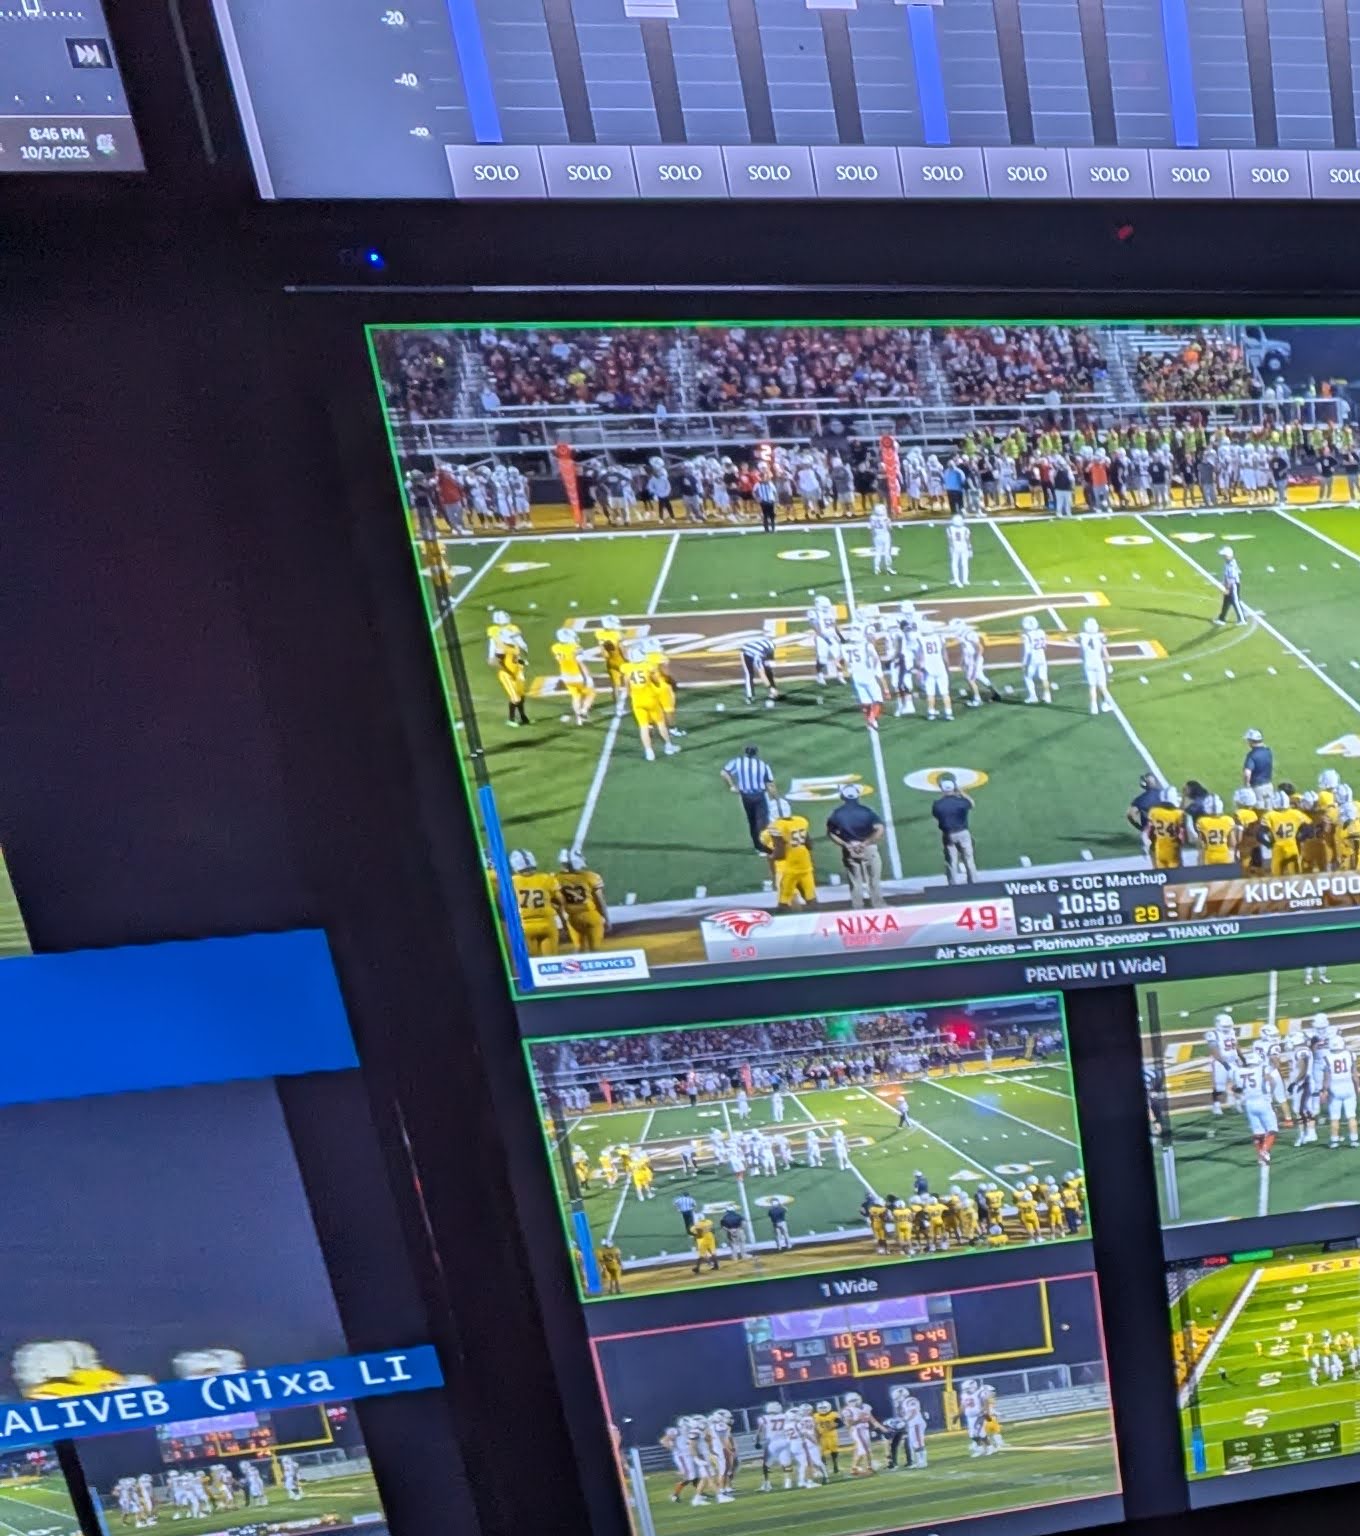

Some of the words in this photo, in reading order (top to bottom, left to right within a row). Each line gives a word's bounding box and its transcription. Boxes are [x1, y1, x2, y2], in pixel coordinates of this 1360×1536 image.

[381, 10, 405, 26] -20
[394, 72, 418, 87] -40
[29, 127, 59, 141] 8:46
[60, 127, 86, 141] PM
[20, 145, 91, 160] 10/3/2025
[474, 165, 519, 182] SOLO
[567, 165, 612, 182] SOLO
[659, 165, 702, 182] SOLO
[748, 165, 791, 182] SOLO
[836, 165, 878, 182] SOLO
[922, 165, 963, 182] SOLO
[1007, 166, 1047, 183] SOLO
[1090, 167, 1129, 183] SOLO
[1171, 167, 1210, 184] SOLO
[1251, 168, 1290, 184] SOLO
[1004, 881, 1048, 897] Week
[1049, 880, 1059, 893] 6
[1106, 872, 1168, 890] Matchup
[1057, 891, 1121, 916] 10:56
[1187, 887, 1210, 914] 7
[955, 905, 999, 932] 49
[1060, 917, 1081, 930] 1st
[1082, 915, 1104, 929] and
[1106, 913, 1123, 927] 10
[1133, 905, 1161, 923] 29
[836, 913, 900, 937] NIXA
[1019, 914, 1055, 933] 3rd
[935, 946, 955, 961] Air
[956, 943, 1016, 961] Services
[1033, 934, 1095, 952] Platinum
[1096, 930, 1151, 950] Sponsor
[1169, 924, 1212, 940] THANK
[1212, 922, 1241, 937] YOU
[1025, 962, 1099, 984] PREVIEW
[1100, 959, 1117, 980] [1
[1118, 955, 1168, 976] Wide]
[820, 1283, 831, 1298] 1
[832, 1277, 879, 1296] Wide
[0, 1389, 170, 1438] ALIVEB
[200, 1368, 336, 1414] (Nixa
[359, 1354, 414, 1386] LI
